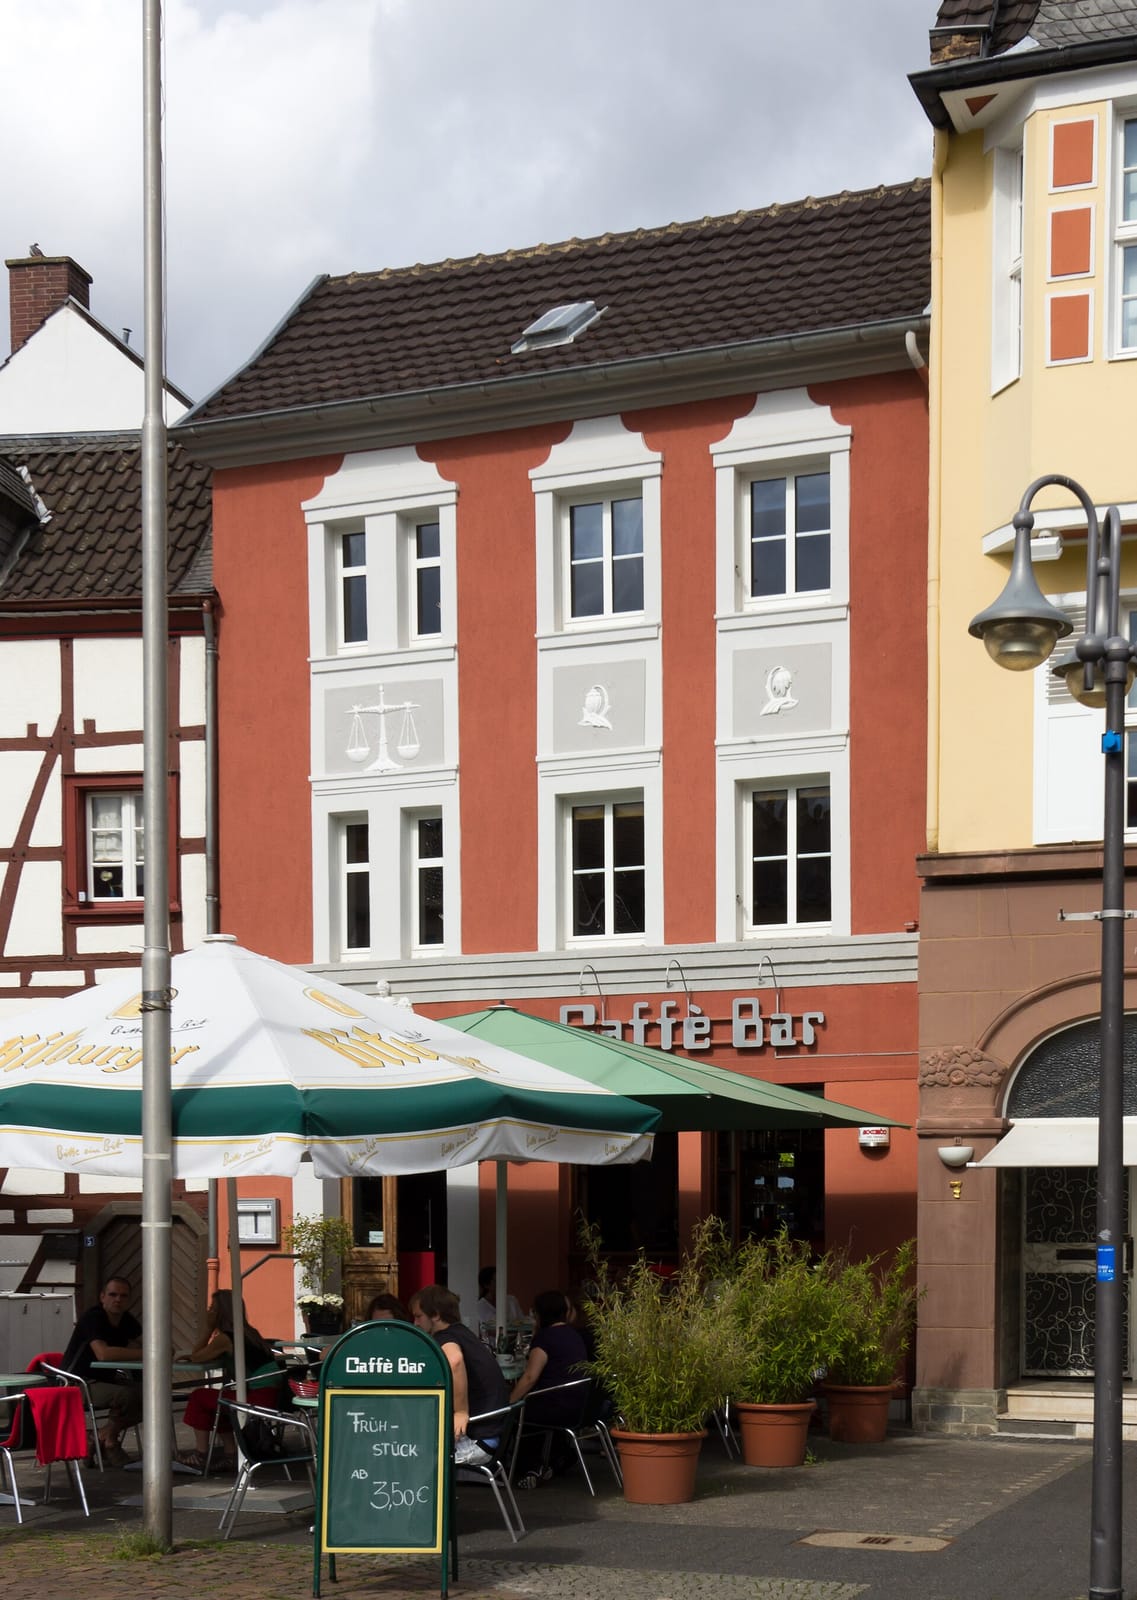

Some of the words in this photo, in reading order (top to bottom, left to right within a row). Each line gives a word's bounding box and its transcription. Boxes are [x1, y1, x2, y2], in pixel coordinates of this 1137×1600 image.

[732, 997, 825, 1048] Bar
[346, 1357, 393, 1373] Caffè
[398, 1357, 426, 1374] Bar
[370, 1481, 429, 1511] 3,50€
